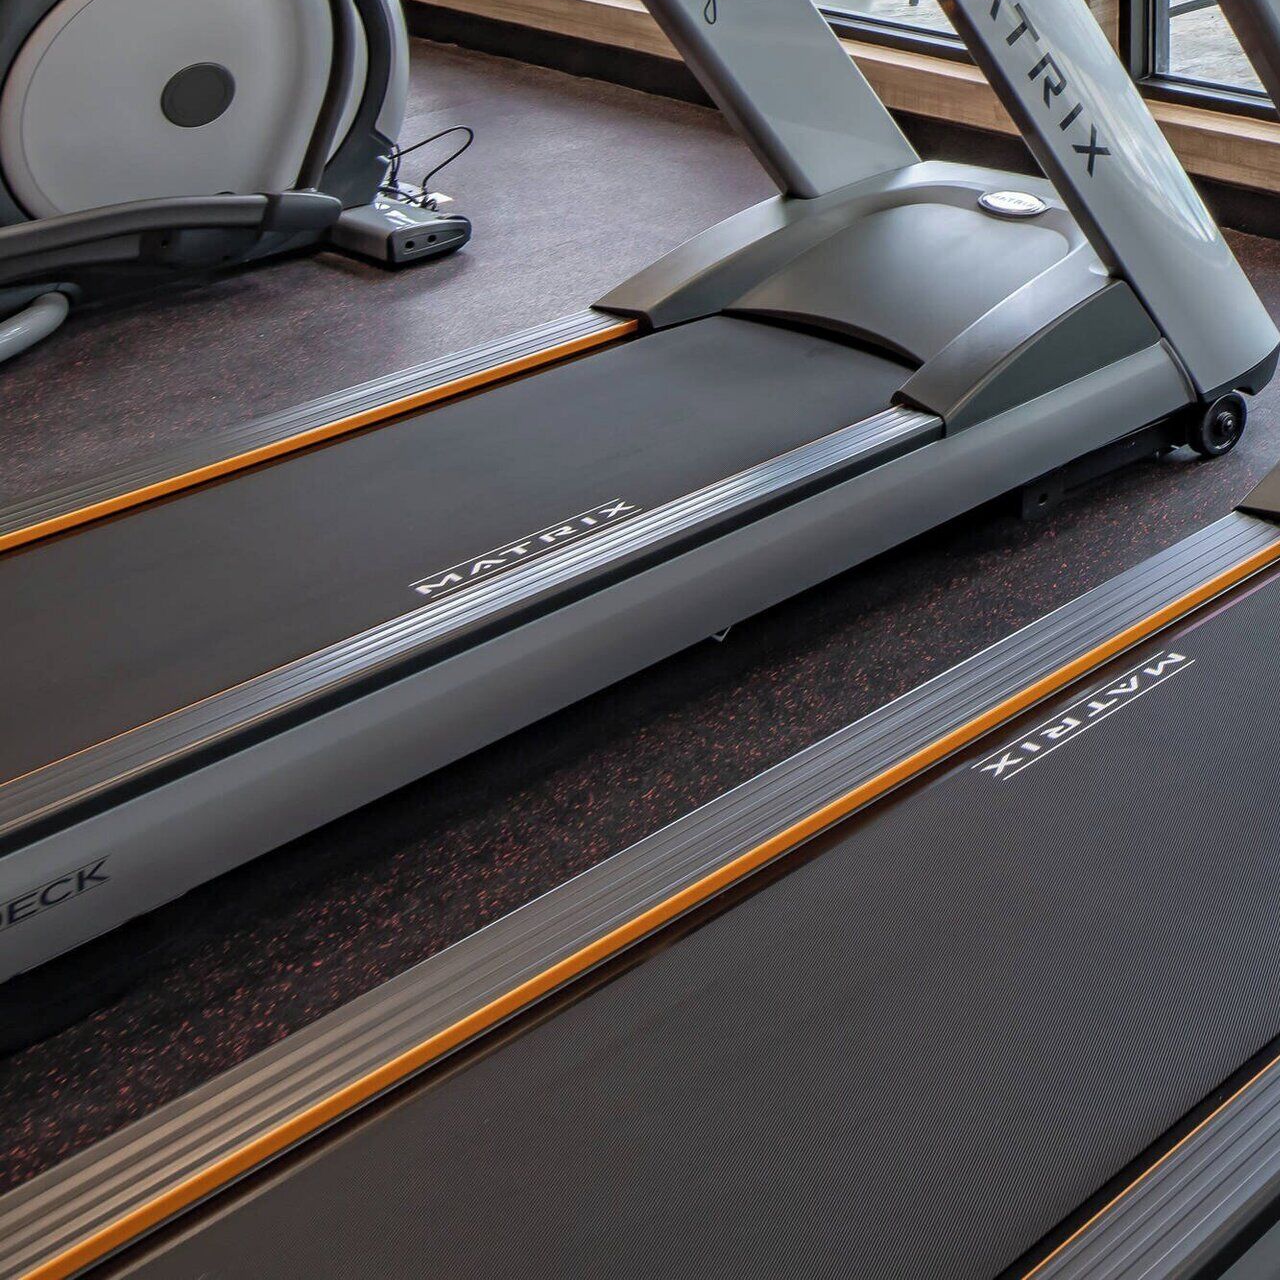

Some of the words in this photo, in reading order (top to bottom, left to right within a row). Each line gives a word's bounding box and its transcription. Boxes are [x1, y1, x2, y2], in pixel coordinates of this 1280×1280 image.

[415, 501, 636, 596] MATRIX
[980, 652, 1187, 778] MATRIX
[0, 858, 110, 925] ECK
